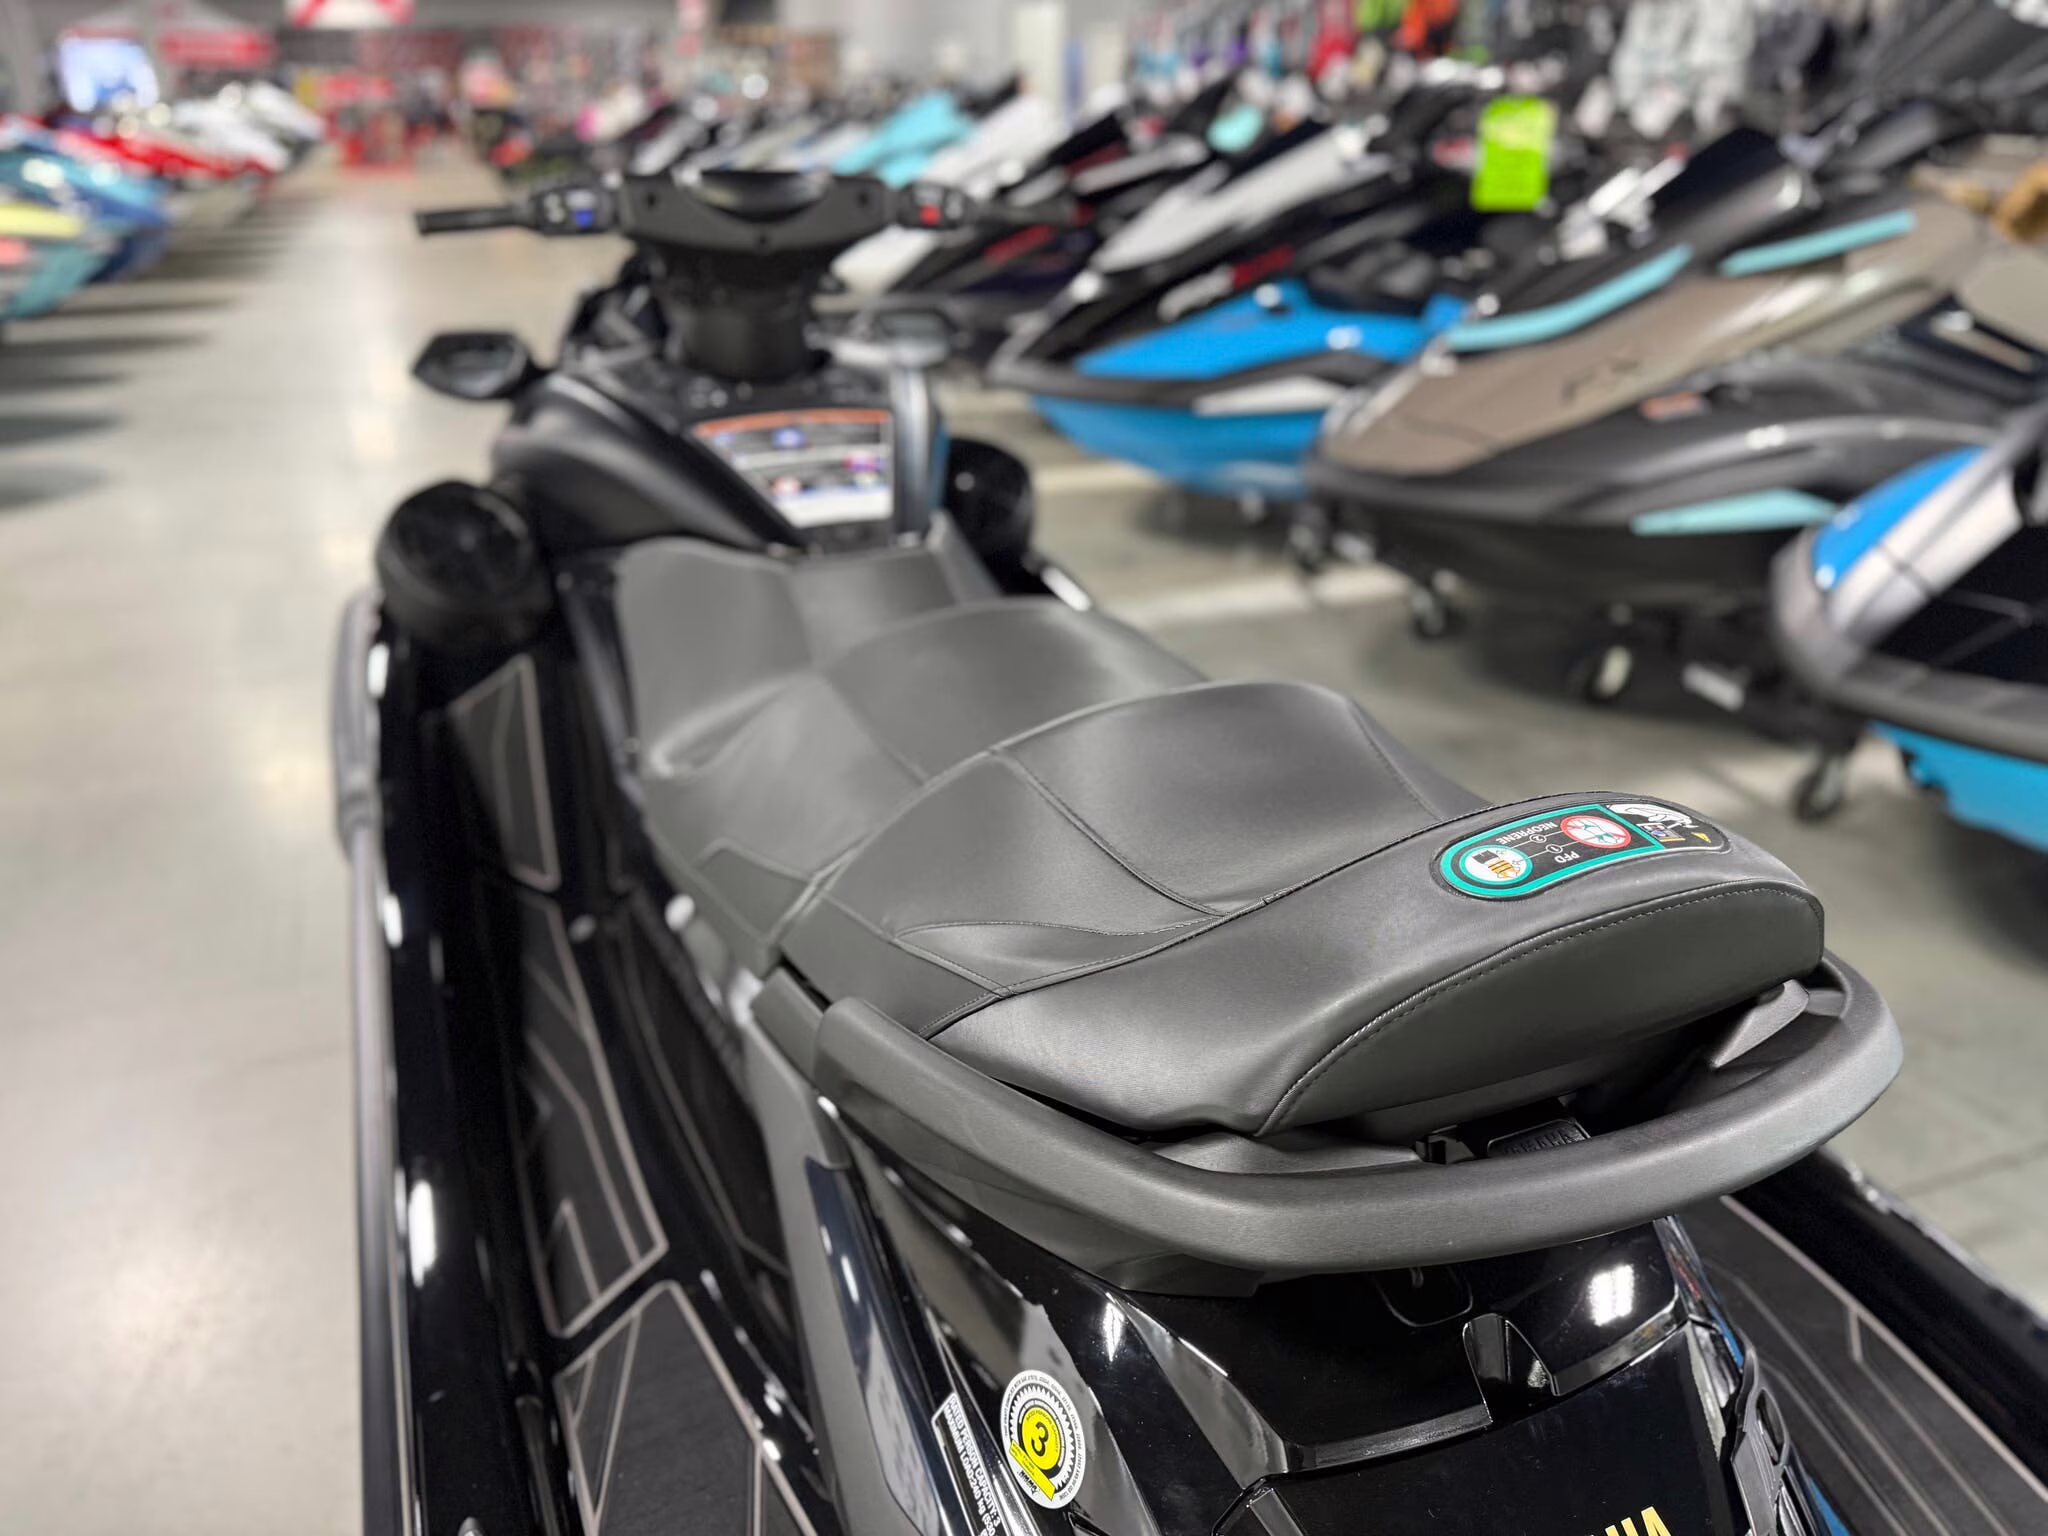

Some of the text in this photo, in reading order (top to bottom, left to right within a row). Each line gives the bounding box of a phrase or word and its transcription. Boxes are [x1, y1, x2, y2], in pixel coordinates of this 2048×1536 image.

[1495, 821, 1558, 846] NEOPRENE
[1554, 850, 1580, 864] PFD
[1031, 1421, 1049, 1457] 3
[943, 1404, 965, 1454] MAXIMUM
[976, 1497, 987, 1516] kg
[960, 1428, 979, 1469] PERSON
[974, 1467, 998, 1519] CAPACITY:
[993, 1516, 1001, 1527] 3
